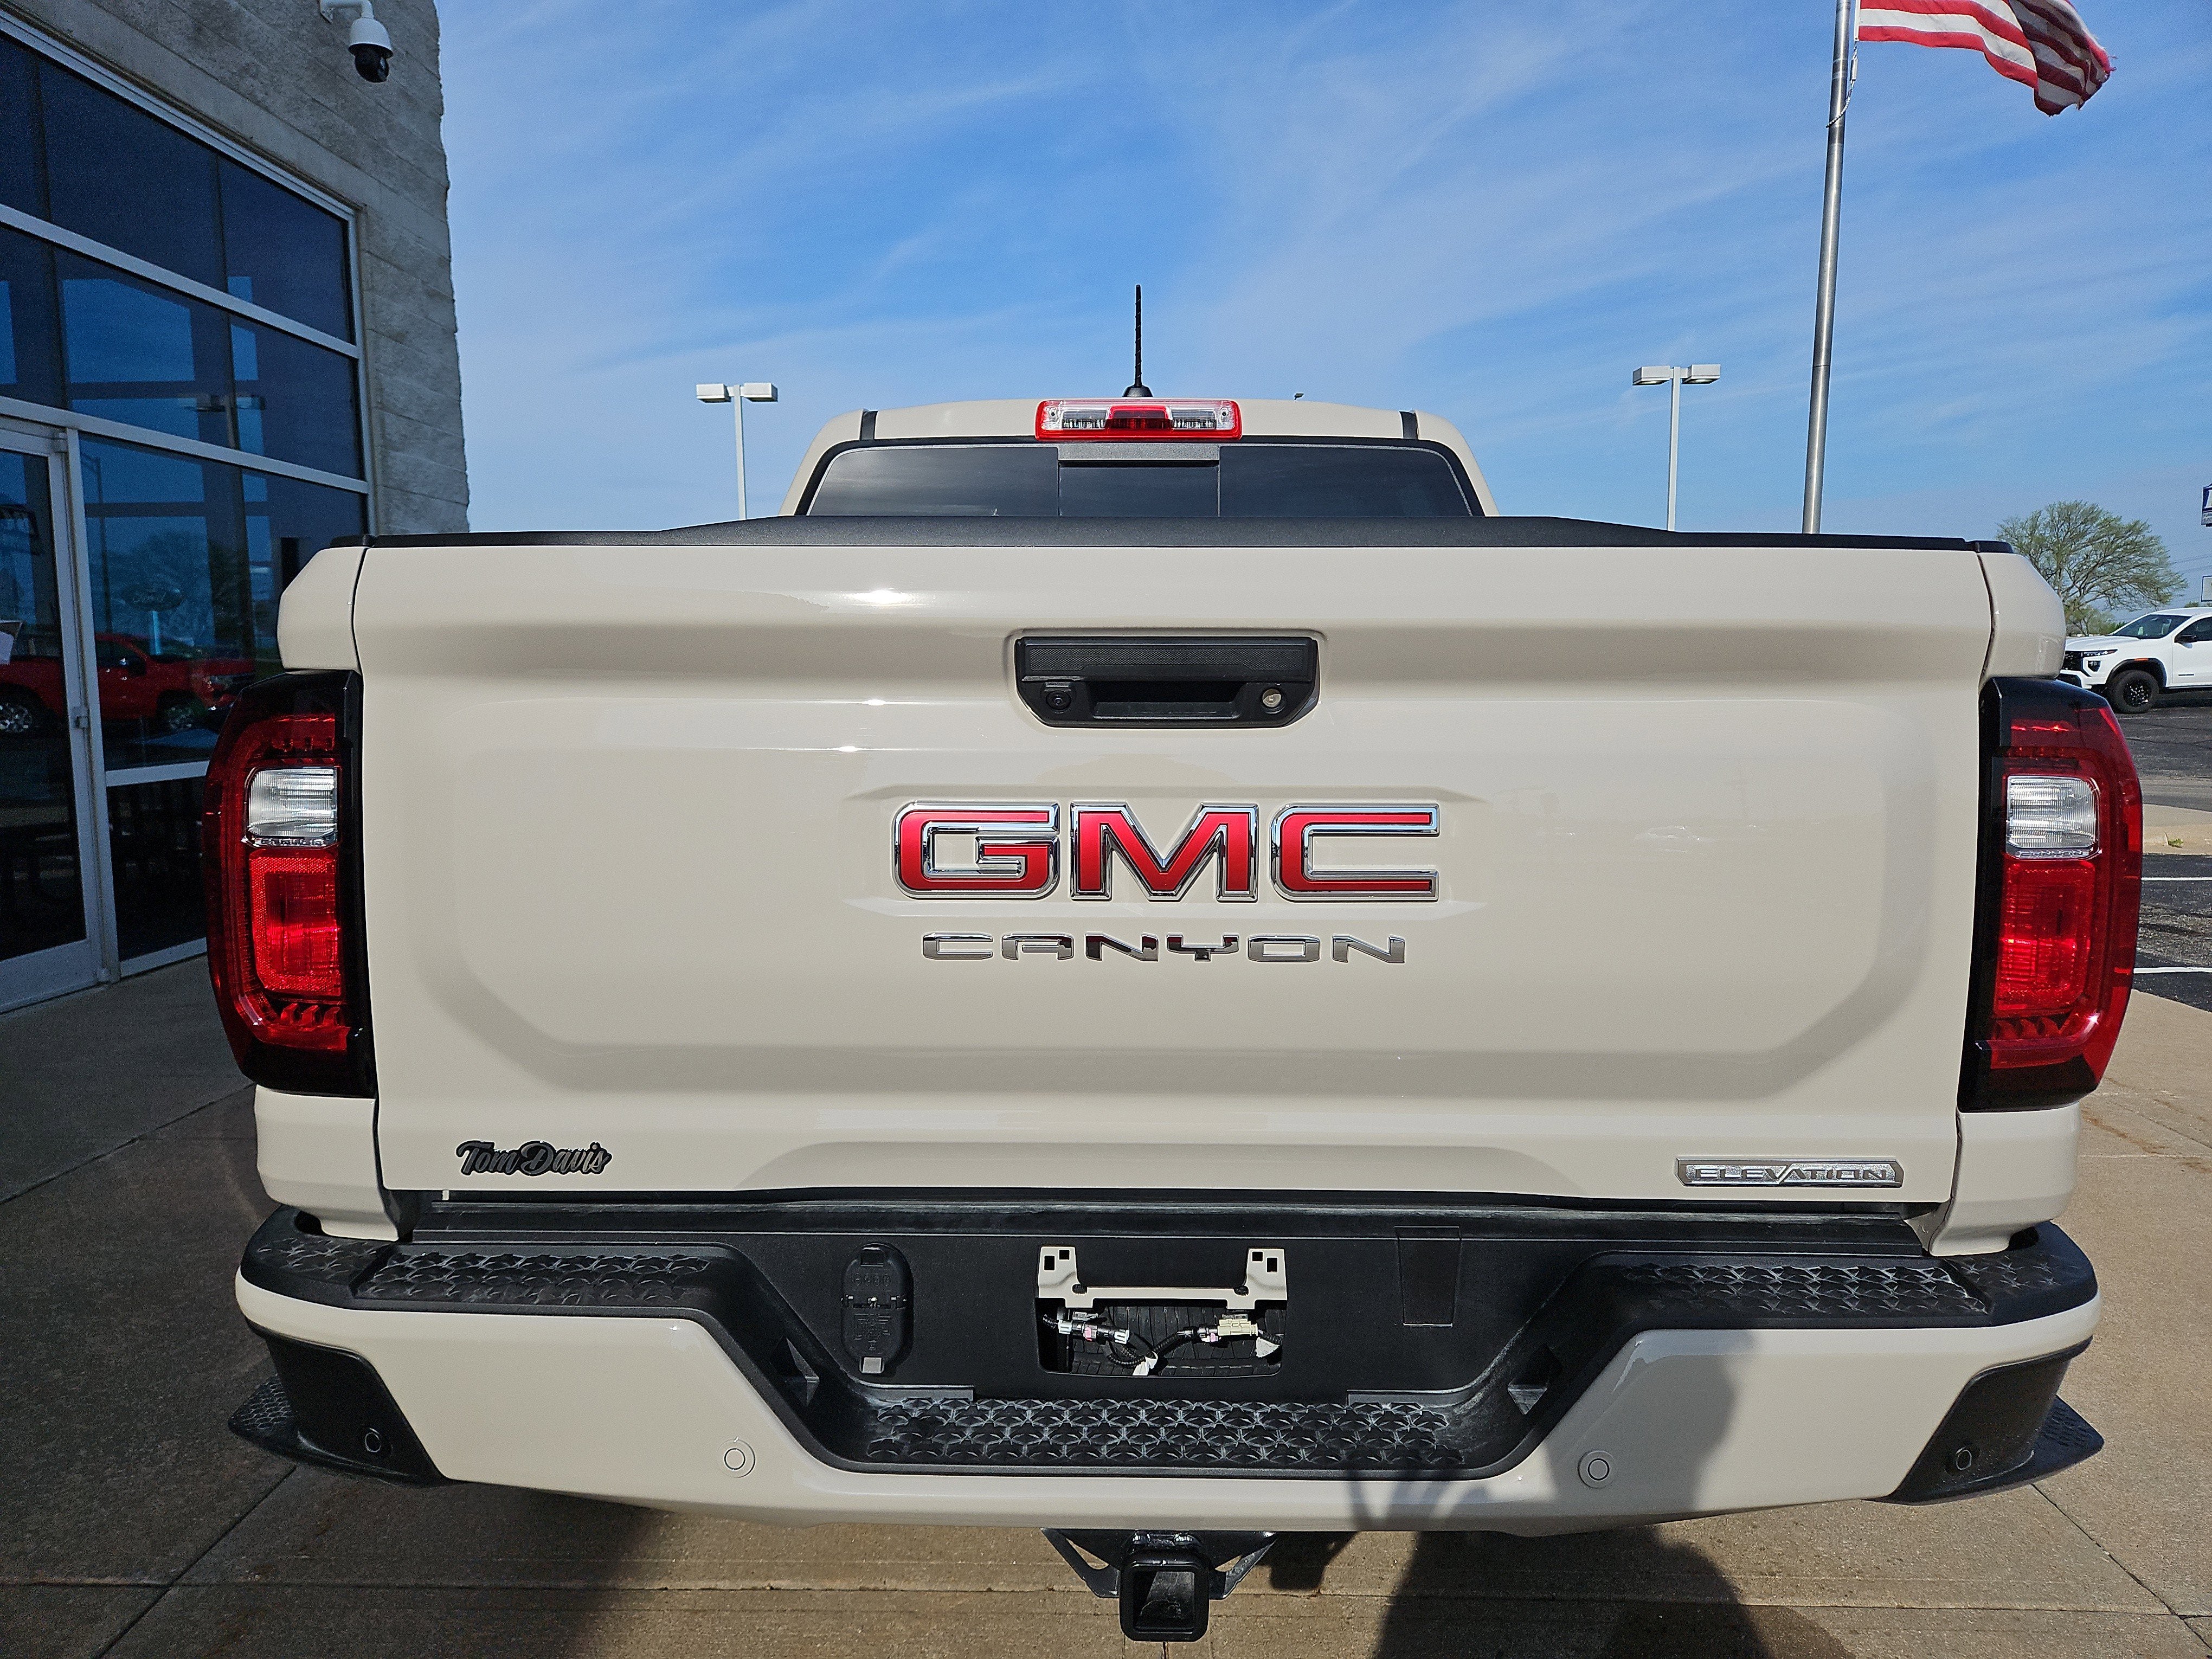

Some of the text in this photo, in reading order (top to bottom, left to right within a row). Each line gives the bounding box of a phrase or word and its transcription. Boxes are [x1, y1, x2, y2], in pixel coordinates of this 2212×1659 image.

[892, 801, 1440, 902] GMC
[923, 933, 1405, 962] CANYON
[456, 1140, 612, 1176] Tom Davis
[1695, 1168, 1888, 1180] ELEVATION
